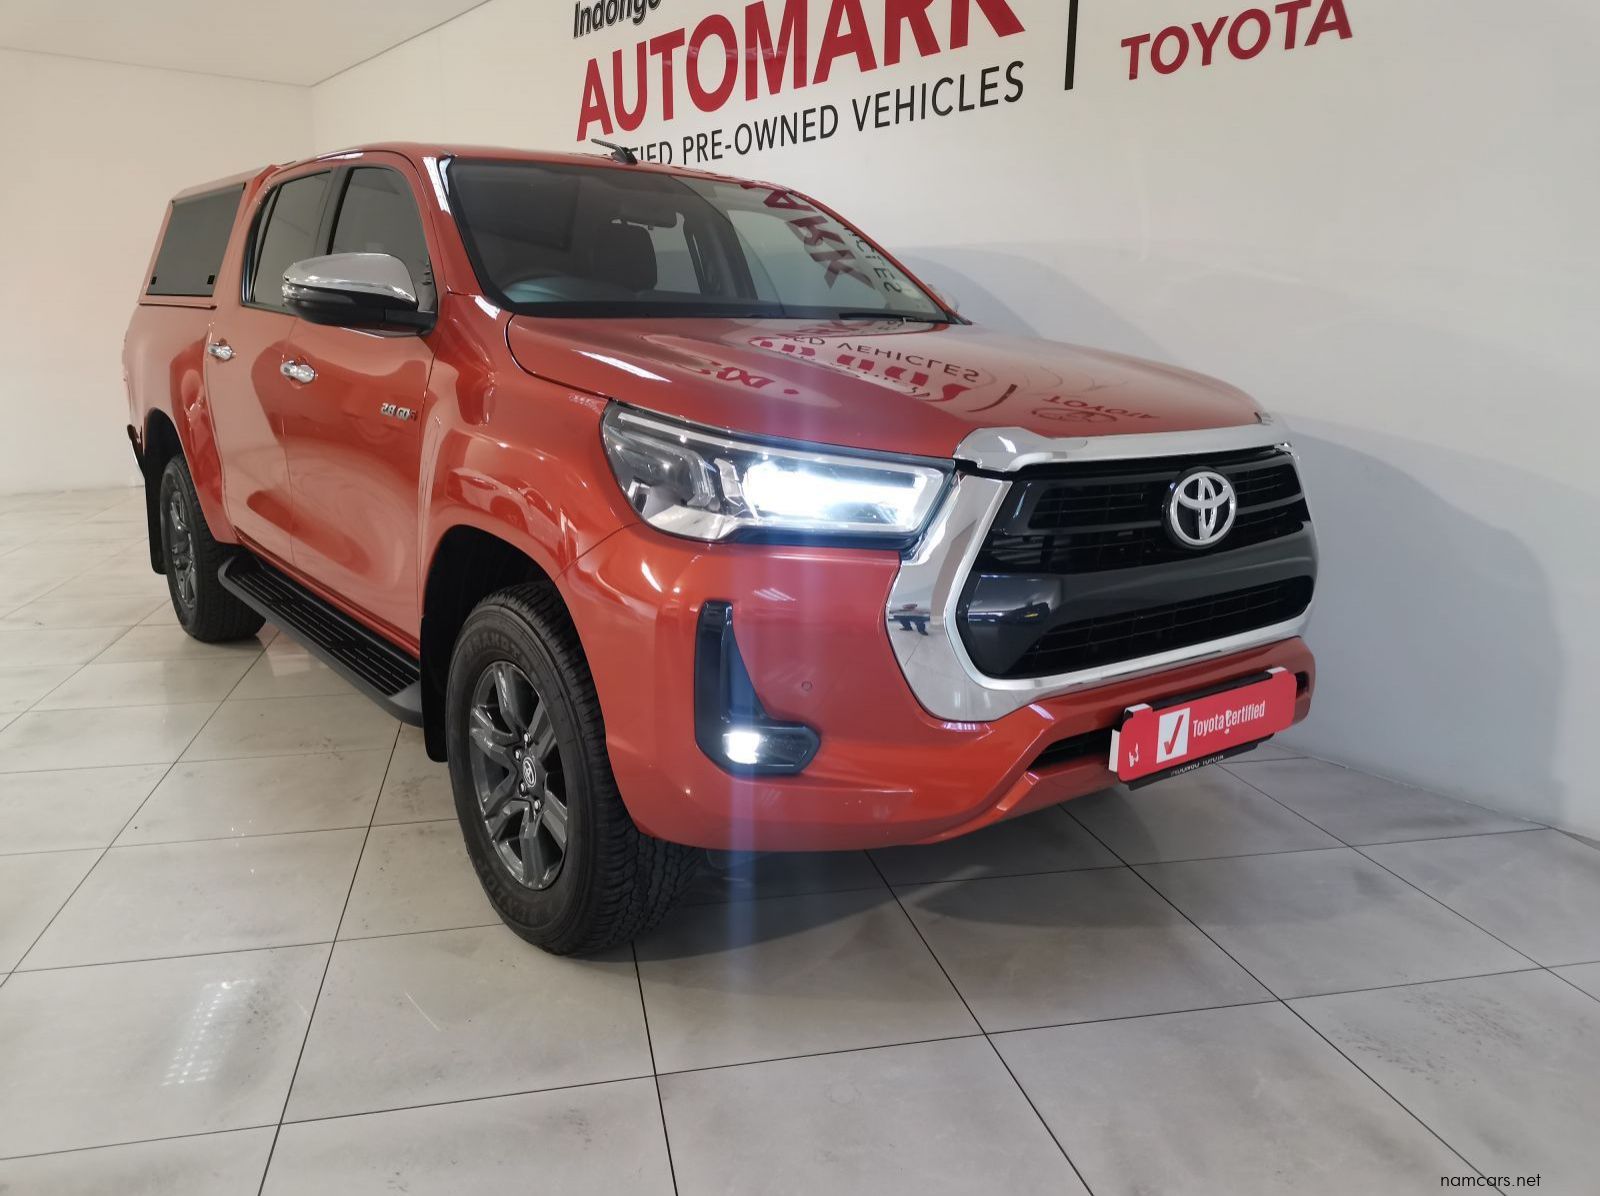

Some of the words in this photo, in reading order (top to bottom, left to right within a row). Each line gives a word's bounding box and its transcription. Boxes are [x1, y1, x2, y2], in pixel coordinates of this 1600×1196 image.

[1120, 0, 1353, 80] TOYOTA
[682, 104, 839, 165] PRE-OWNED
[852, 60, 1025, 131] VEHICLES
[1193, 713, 1224, 738] Toyota
[1225, 699, 1265, 727] Certified
